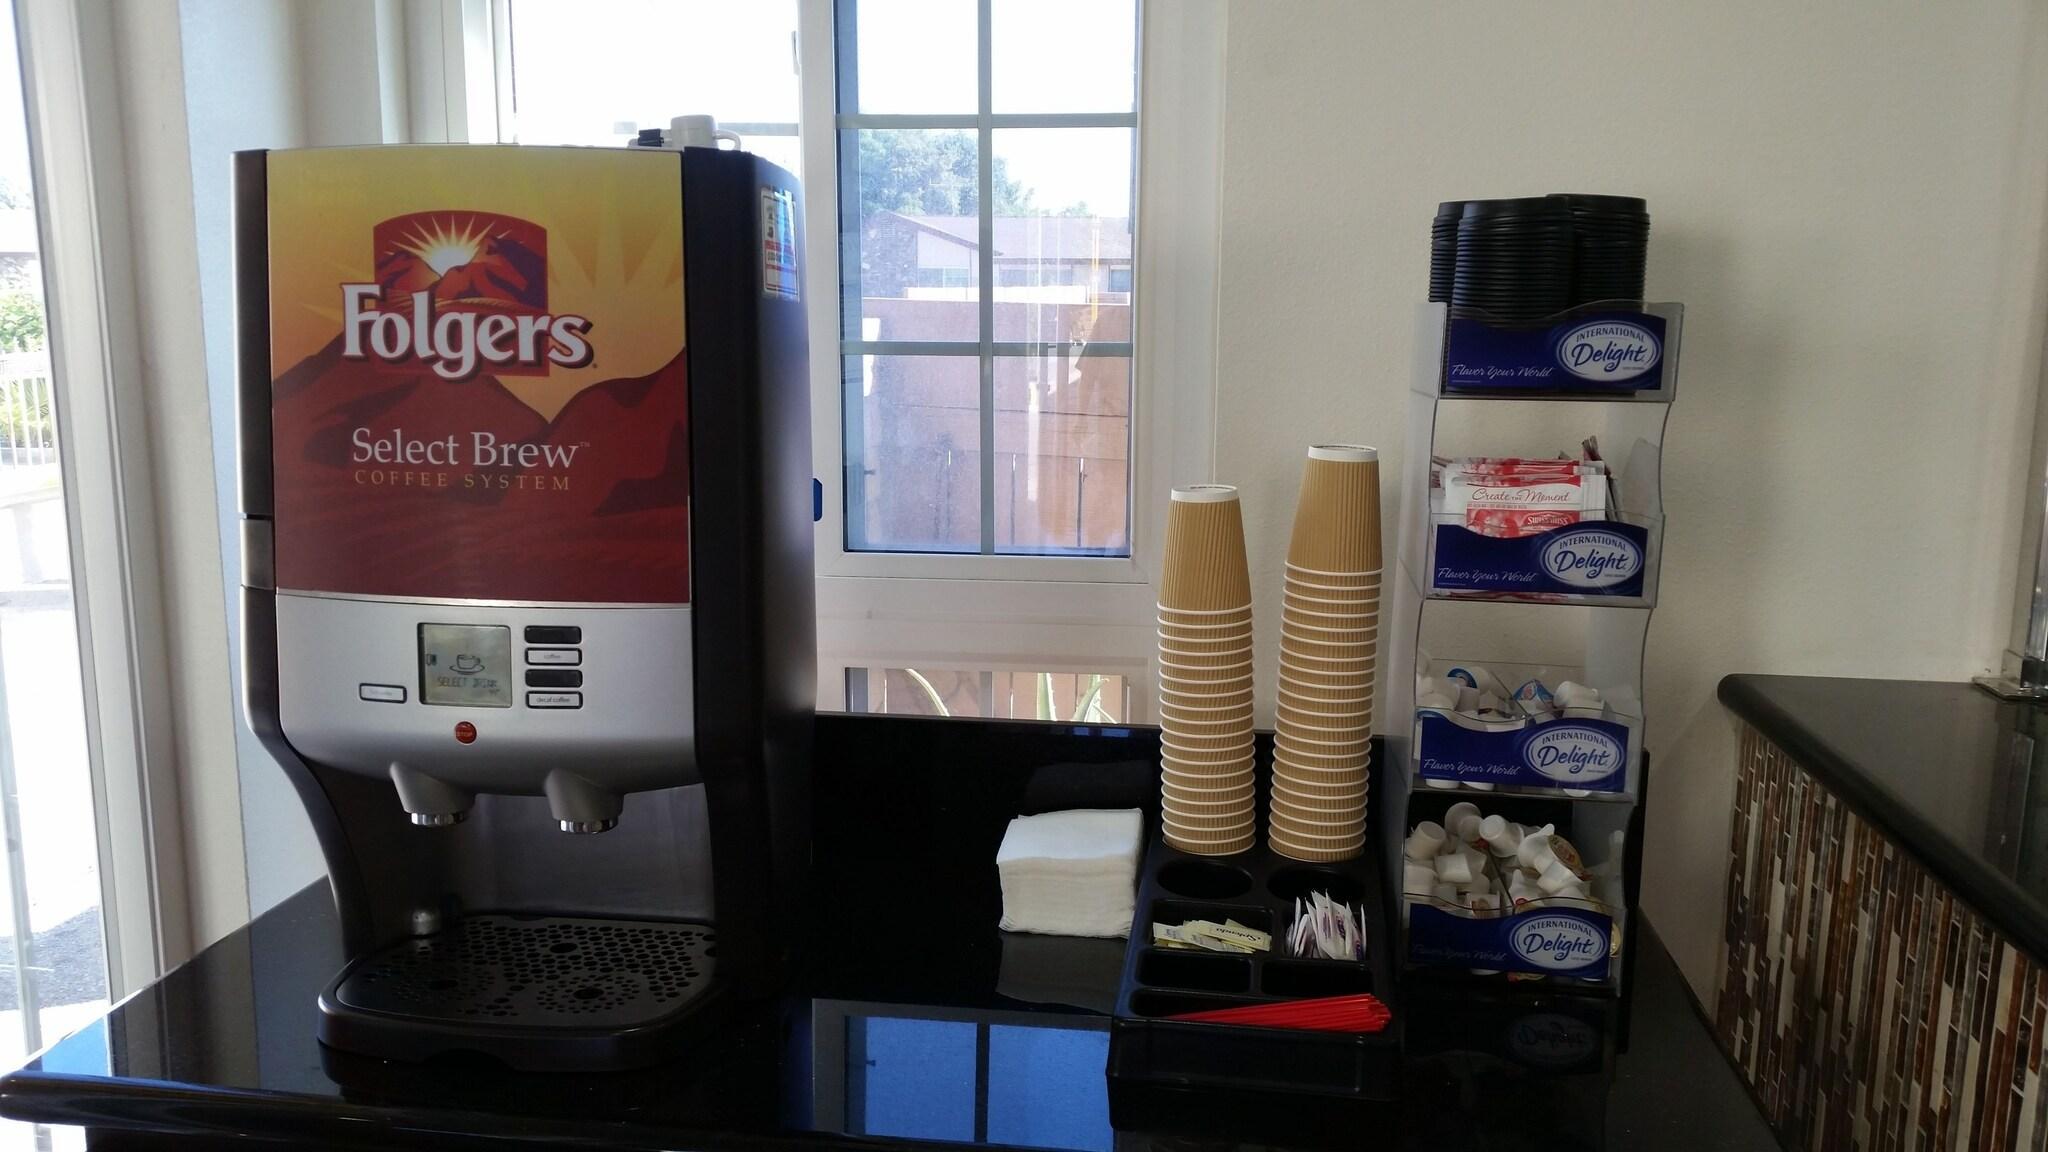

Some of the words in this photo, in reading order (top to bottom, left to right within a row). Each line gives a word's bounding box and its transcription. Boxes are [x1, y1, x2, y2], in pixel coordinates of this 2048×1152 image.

[341, 283, 594, 380] Folgers
[1575, 327, 1645, 343] INTERNATIONAL
[1571, 341, 1649, 372] Delight
[1451, 364, 1485, 376] Flavor
[1487, 366, 1515, 379] Your
[1517, 366, 1553, 377] World
[352, 427, 460, 464] Select
[470, 431, 578, 469] Brew
[355, 469, 448, 487] COFFEE
[464, 474, 570, 490] SYSTEM
[1471, 488, 1510, 501] Create
[1516, 489, 1570, 502] Moment
[1559, 535, 1627, 551] INTERNATIONAL
[1554, 549, 1628, 579] Delight
[1438, 567, 1471, 580] Flavor
[1472, 569, 1499, 583] Your
[1502, 571, 1538, 582] World
[1541, 732, 1609, 748] INTERNATIONAL
[1424, 758, 1456, 771] Flavor
[1456, 760, 1484, 774] Your
[1486, 763, 1522, 776] World
[1537, 745, 1610, 774] Delight
[1527, 920, 1593, 937] INTERNATIONAL
[1523, 933, 1595, 961] Delight
